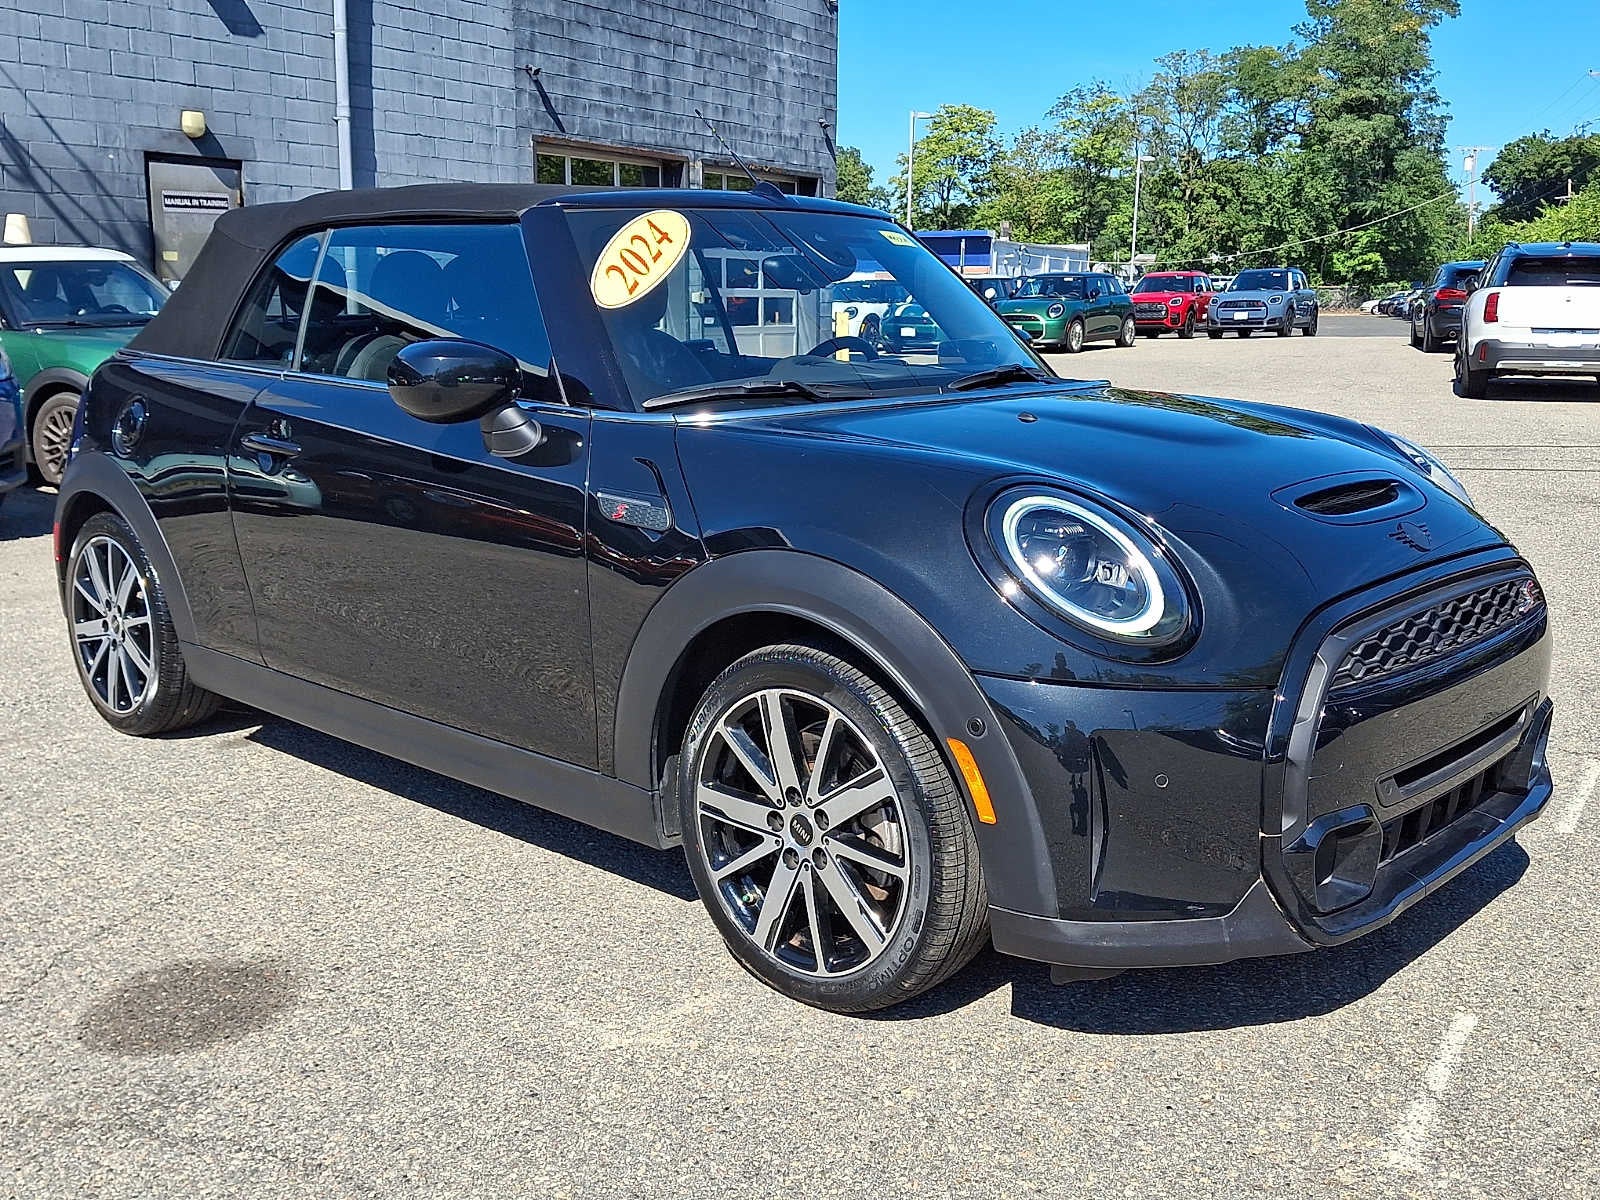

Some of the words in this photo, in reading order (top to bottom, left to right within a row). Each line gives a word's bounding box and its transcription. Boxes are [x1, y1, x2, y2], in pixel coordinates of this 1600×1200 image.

[200, 199, 228, 208] TRAINING
[606, 219, 672, 295] 2024
[792, 820, 810, 842] MINI
